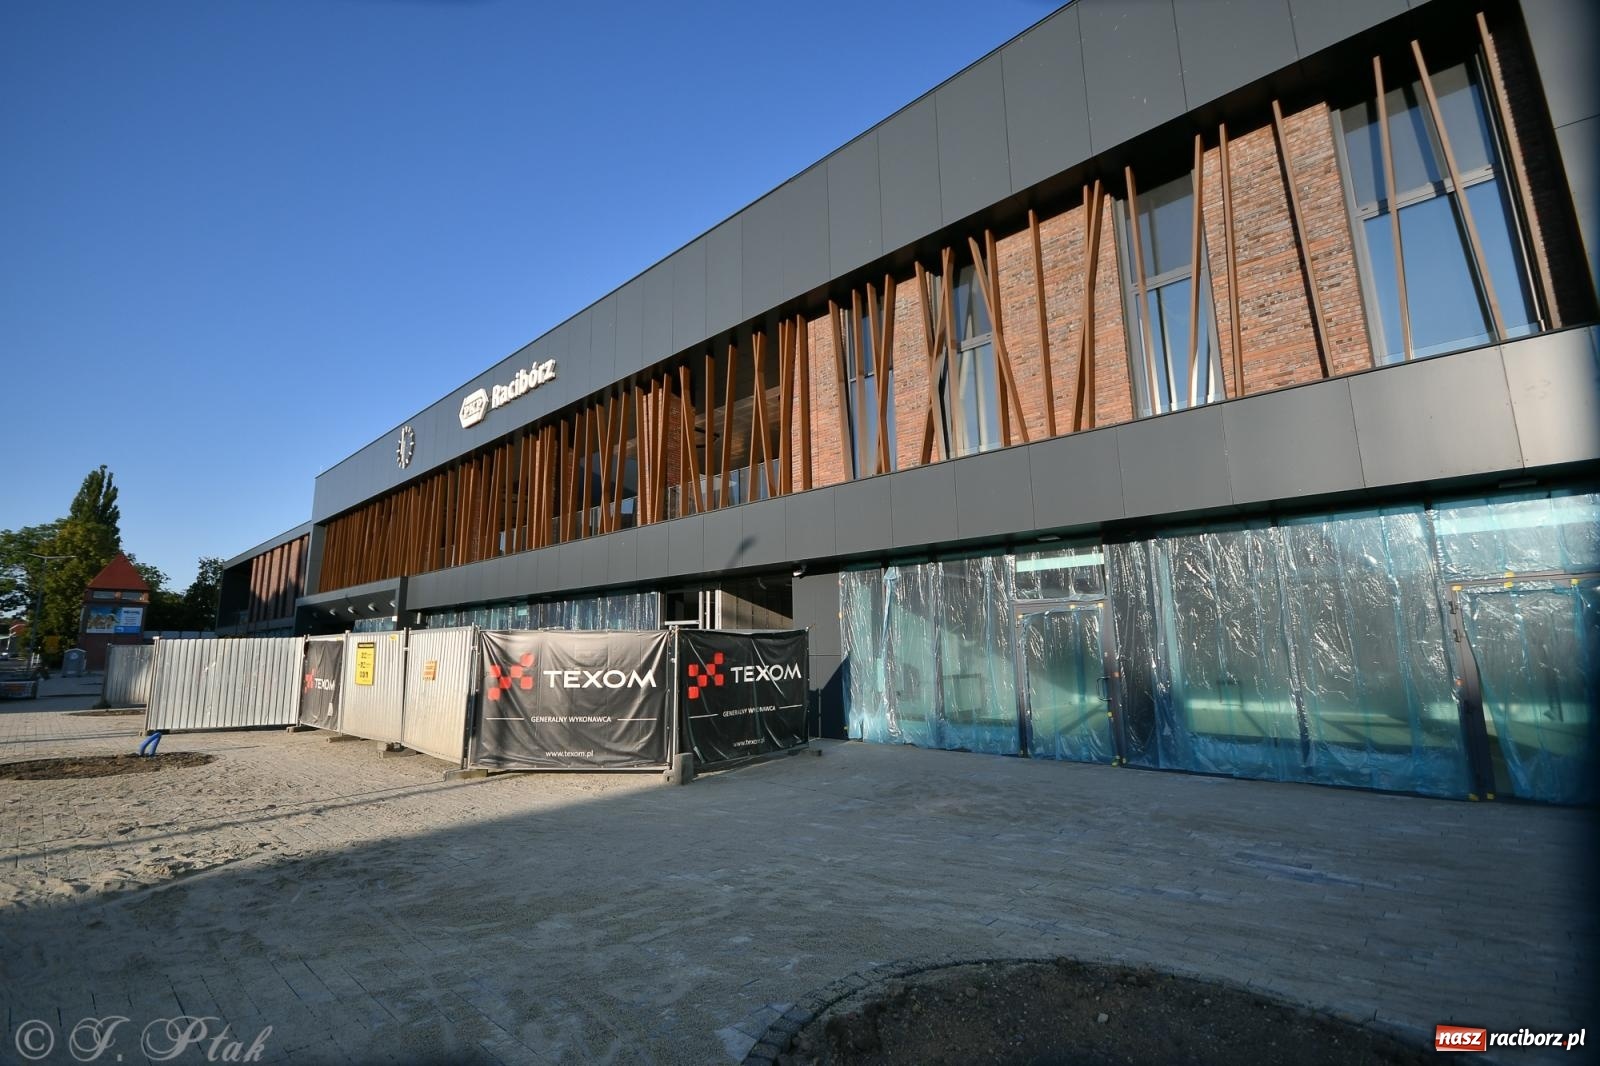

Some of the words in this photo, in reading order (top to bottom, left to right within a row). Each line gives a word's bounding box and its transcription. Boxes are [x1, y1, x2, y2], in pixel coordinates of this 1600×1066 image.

[492, 359, 556, 408] Racibórz
[543, 669, 657, 688] TEXOM
[730, 663, 802, 683] TEXOM
[314, 678, 335, 690] TEXOM
[545, 750, 594, 758] www.texom.pl
